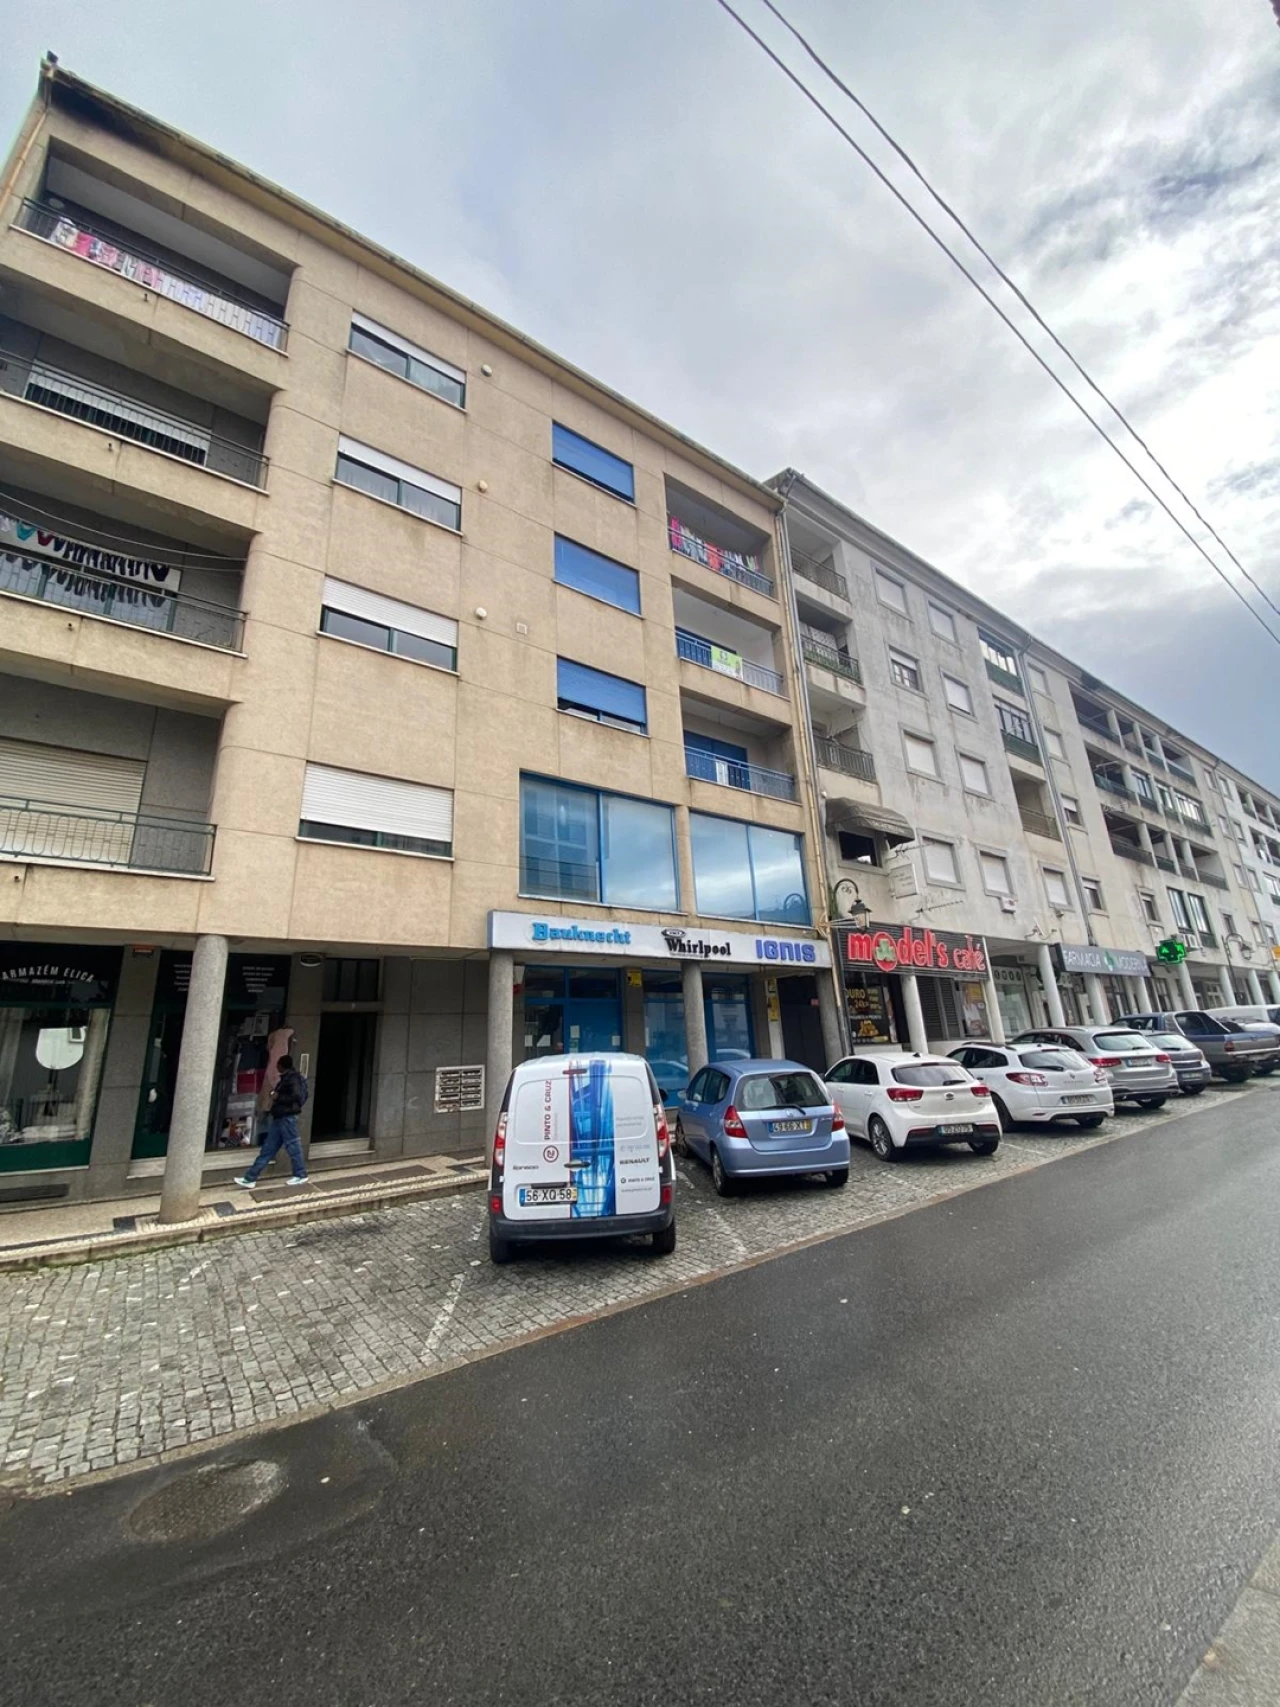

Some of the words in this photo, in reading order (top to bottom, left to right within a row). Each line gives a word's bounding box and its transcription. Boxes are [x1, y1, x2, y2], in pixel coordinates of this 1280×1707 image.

[531, 922, 632, 945] Bauknecht
[664, 937, 732, 958] Whirlpool
[755, 939, 816, 963] IGNIS
[953, 935, 985, 971] café
[2, 964, 59, 981] ARMAZÉM
[544, 1080, 552, 1103] CRUZ
[543, 1114, 552, 1141] PINTO
[619, 1157, 650, 1165] RENAULT
[526, 1187, 572, 1202] 56-XQ-58
